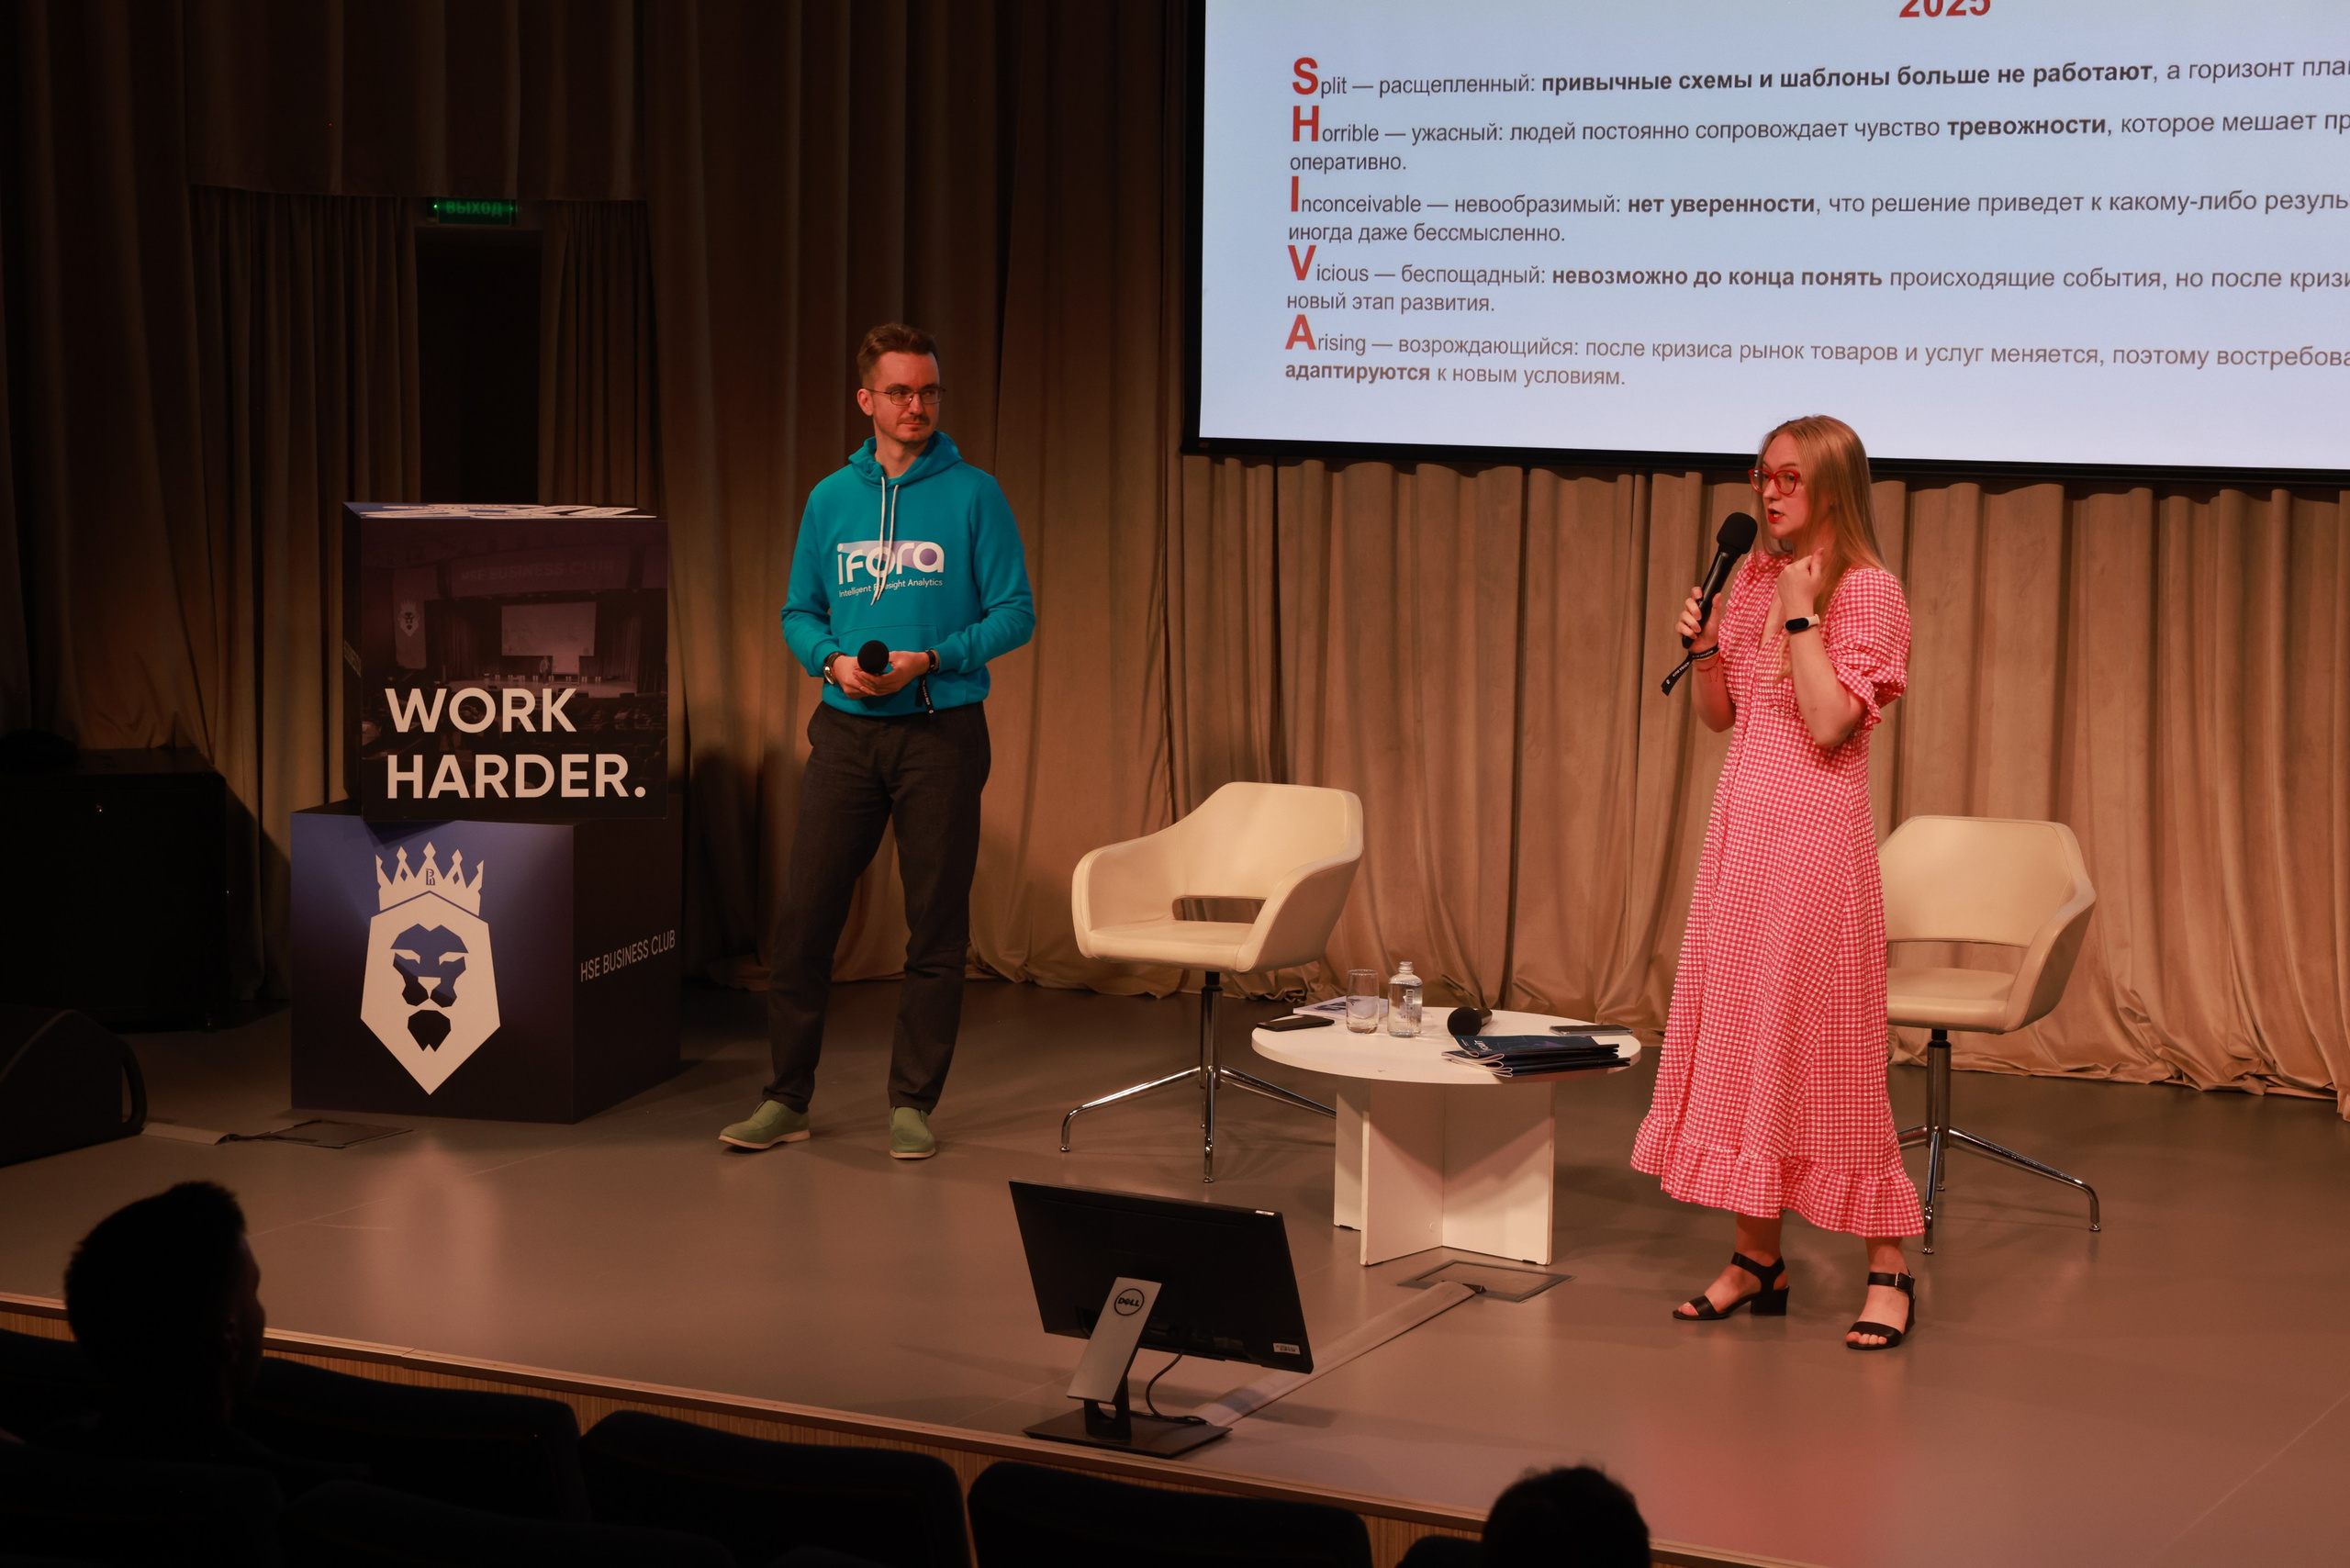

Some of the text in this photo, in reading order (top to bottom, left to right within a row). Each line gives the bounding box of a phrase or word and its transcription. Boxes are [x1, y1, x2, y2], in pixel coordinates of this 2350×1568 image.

[1899, 0, 1990, 17] 2025
[1292, 57, 1347, 99] Split
[1380, 73, 1534, 98] расщепленный:
[1542, 75, 1672, 96] привычные
[1679, 74, 1751, 89] схемы
[1760, 73, 1773, 87] и
[1781, 67, 1889, 87] шаблоны
[1897, 65, 1989, 85] больше
[1998, 68, 2025, 83] не
[2033, 62, 2157, 87] работают,
[2167, 64, 2180, 80] а
[2189, 62, 2295, 84] горизонт
[2303, 61, 2350, 76] пла
[1292, 106, 1379, 141] Horrible
[1412, 123, 1503, 146] ужасный:
[1509, 122, 1575, 143] людей
[1583, 125, 1689, 140] постоянно
[1695, 123, 1848, 143] сопровождает
[1855, 121, 1940, 141] чувство
[1947, 118, 2111, 140] тревожности,
[2121, 117, 2214, 138] которое
[2222, 115, 2317, 131] мешает
[1290, 156, 1405, 174] оперативно.
[446, 200, 503, 217] ВЫХОД
[1291, 175, 1421, 212] Inconceivable
[1455, 194, 1620, 217] невообразимый:
[1628, 198, 1664, 213] нет
[1671, 198, 1820, 218] уверенности,
[1830, 198, 1864, 212] что
[1872, 197, 1970, 217] решение
[1978, 196, 2084, 217] приведет
[2092, 196, 2102, 210] к
[2109, 190, 2256, 216] какому-либо
[1289, 222, 1564, 243] иногда даже бессмысленно.
[1287, 245, 1369, 282] Vicious
[1402, 264, 1545, 286] беспощадный:
[1553, 270, 1687, 285] невозможно
[1694, 271, 1721, 288] до
[1729, 271, 1794, 288] конца
[1802, 272, 1882, 286] понять
[1890, 272, 2054, 291] происходящие
[2064, 267, 2166, 290] события,
[2177, 273, 2203, 287] но
[2212, 273, 2282, 287] после
[1288, 292, 1494, 315] новый этап развития.
[1285, 314, 1365, 356] Arising
[1399, 337, 1578, 358] возрождающийся:
[1586, 342, 1645, 356] после
[1652, 343, 1731, 362] кризиса
[1740, 344, 1804, 363] рынок
[1811, 346, 1897, 364] товаров
[1906, 347, 1917, 361] и
[1925, 347, 1984, 366] услуг
[1991, 348, 2103, 366] меняется,
[2113, 350, 2210, 370] поэтому
[1285, 364, 1625, 387] адаптируются к новым условиям.
[838, 577, 944, 598] Intelligent Fesight Analytics
[385, 688, 576, 734] WORK
[386, 753, 646, 800] HARDER.
[580, 929, 676, 983] HSE BUSINESS CLUB
[1117, 1297, 1139, 1307] DELL
